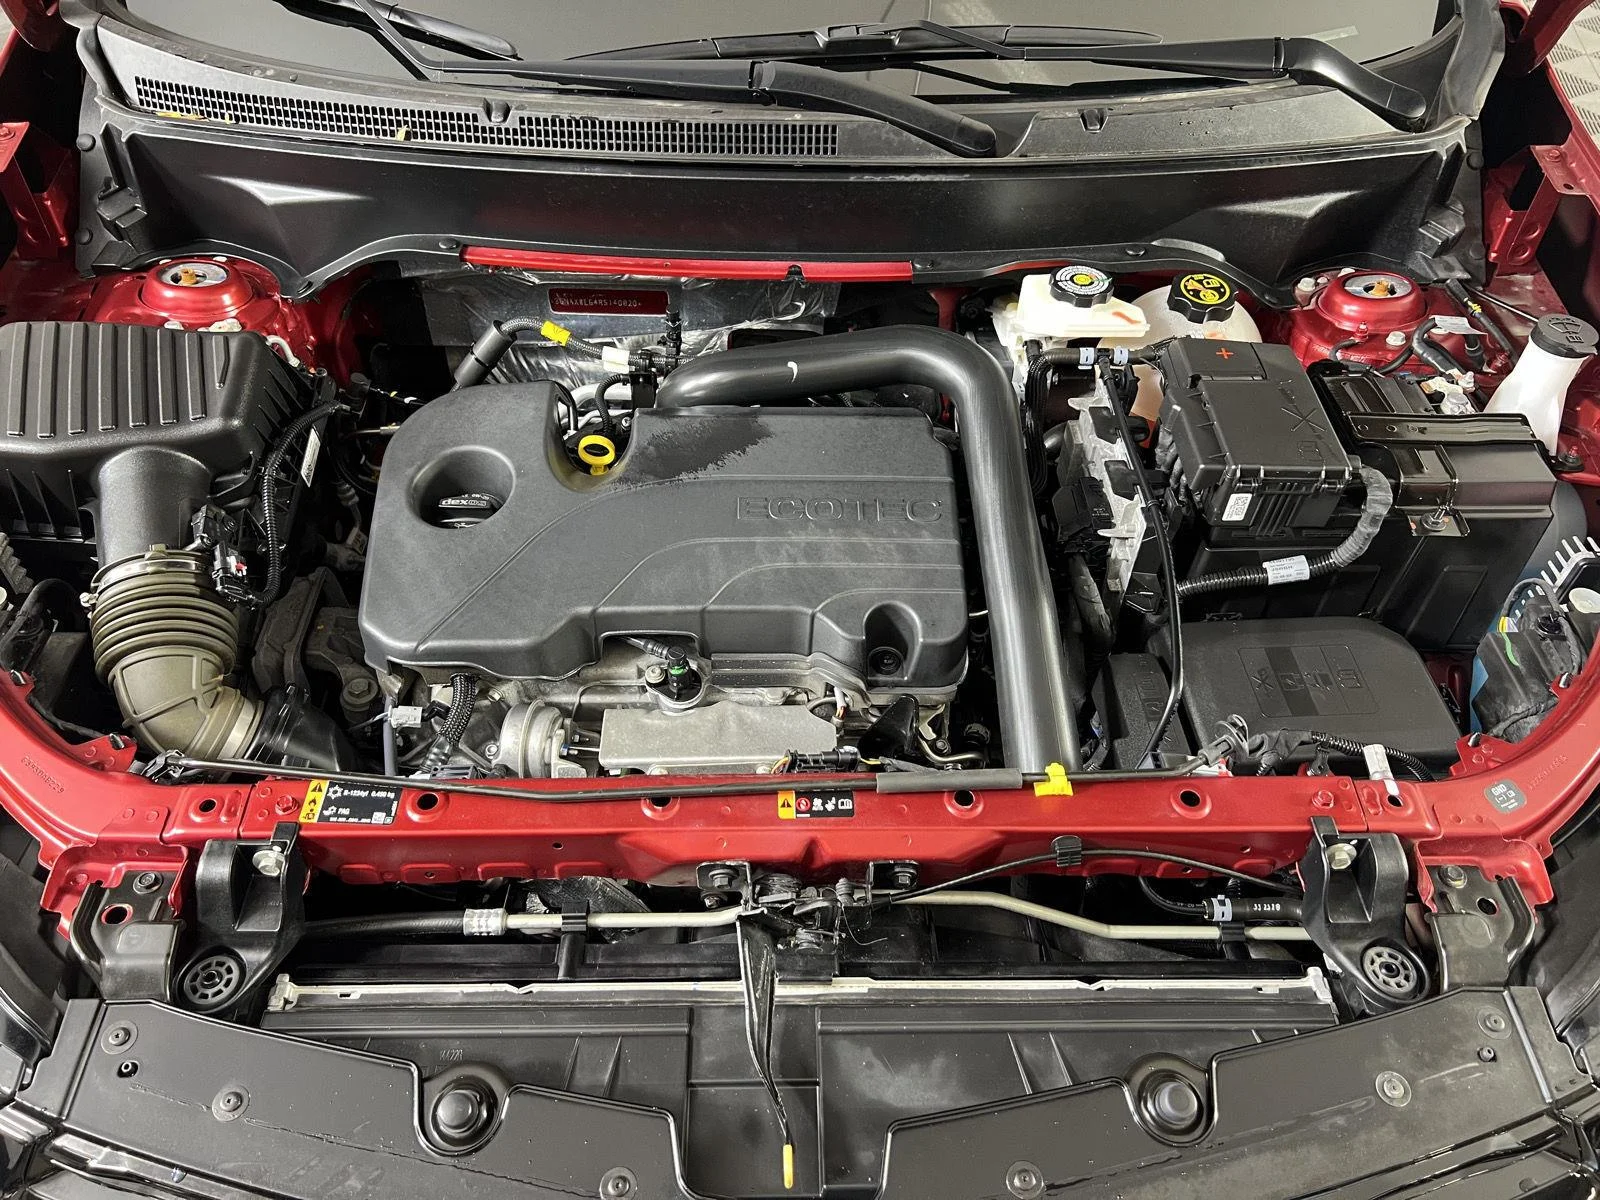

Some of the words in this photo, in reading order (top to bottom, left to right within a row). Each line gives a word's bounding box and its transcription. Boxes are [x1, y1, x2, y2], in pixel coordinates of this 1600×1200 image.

[441, 498, 487, 507] dexos
[736, 496, 943, 522] ECOTEC
[1491, 783, 1507, 796] GND
[337, 807, 350, 815] PAG
